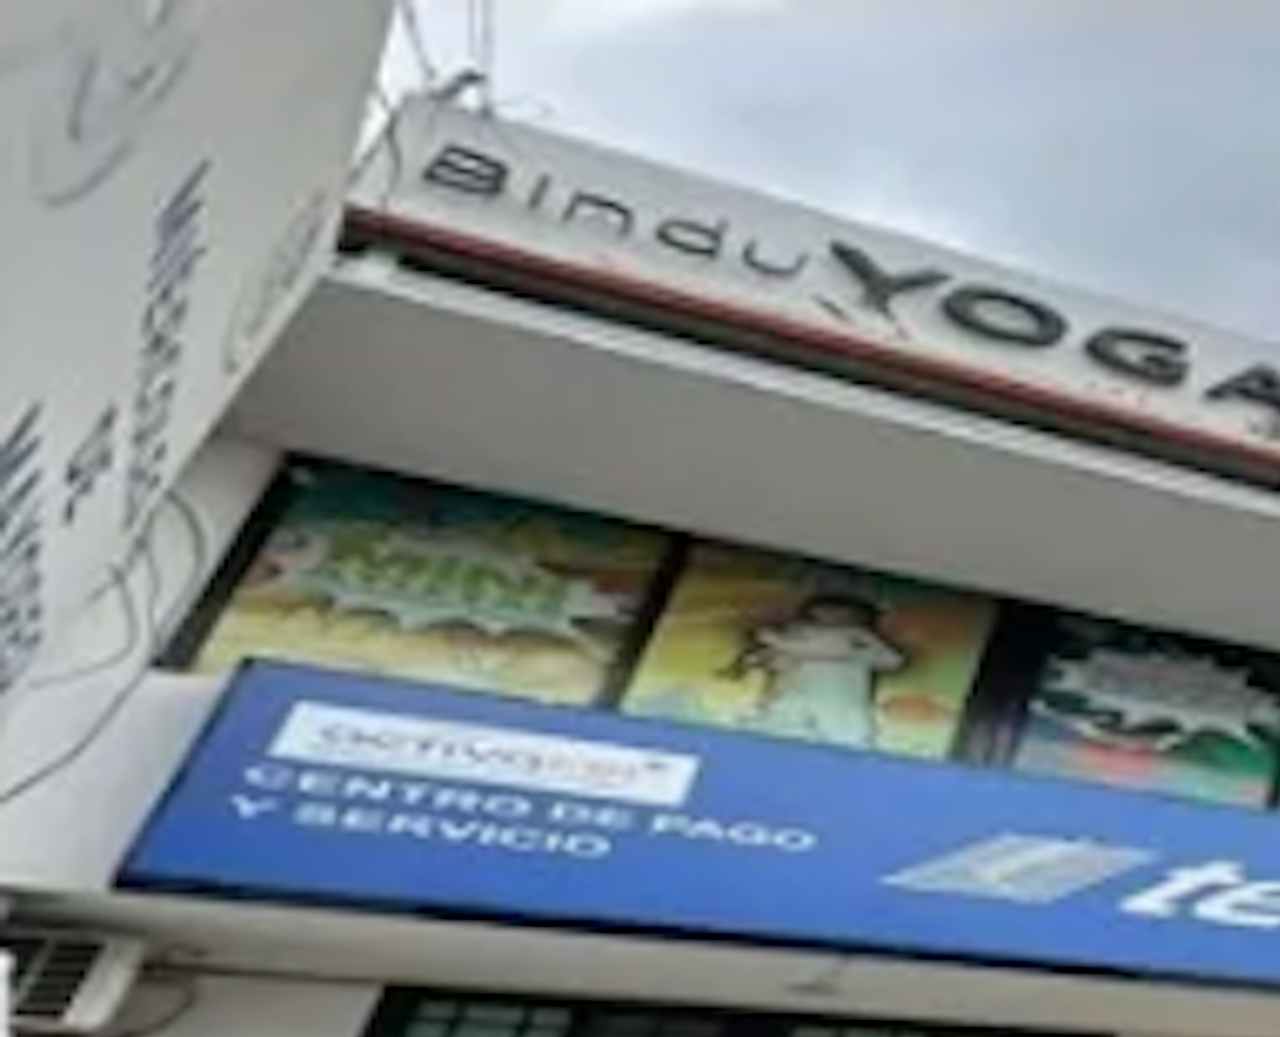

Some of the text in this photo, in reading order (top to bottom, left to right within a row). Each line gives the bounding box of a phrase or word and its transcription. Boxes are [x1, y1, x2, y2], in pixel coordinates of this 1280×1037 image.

[229, 794, 613, 859] Y SERVICIO
[240, 763, 820, 853] CENTRO DE PAGO
